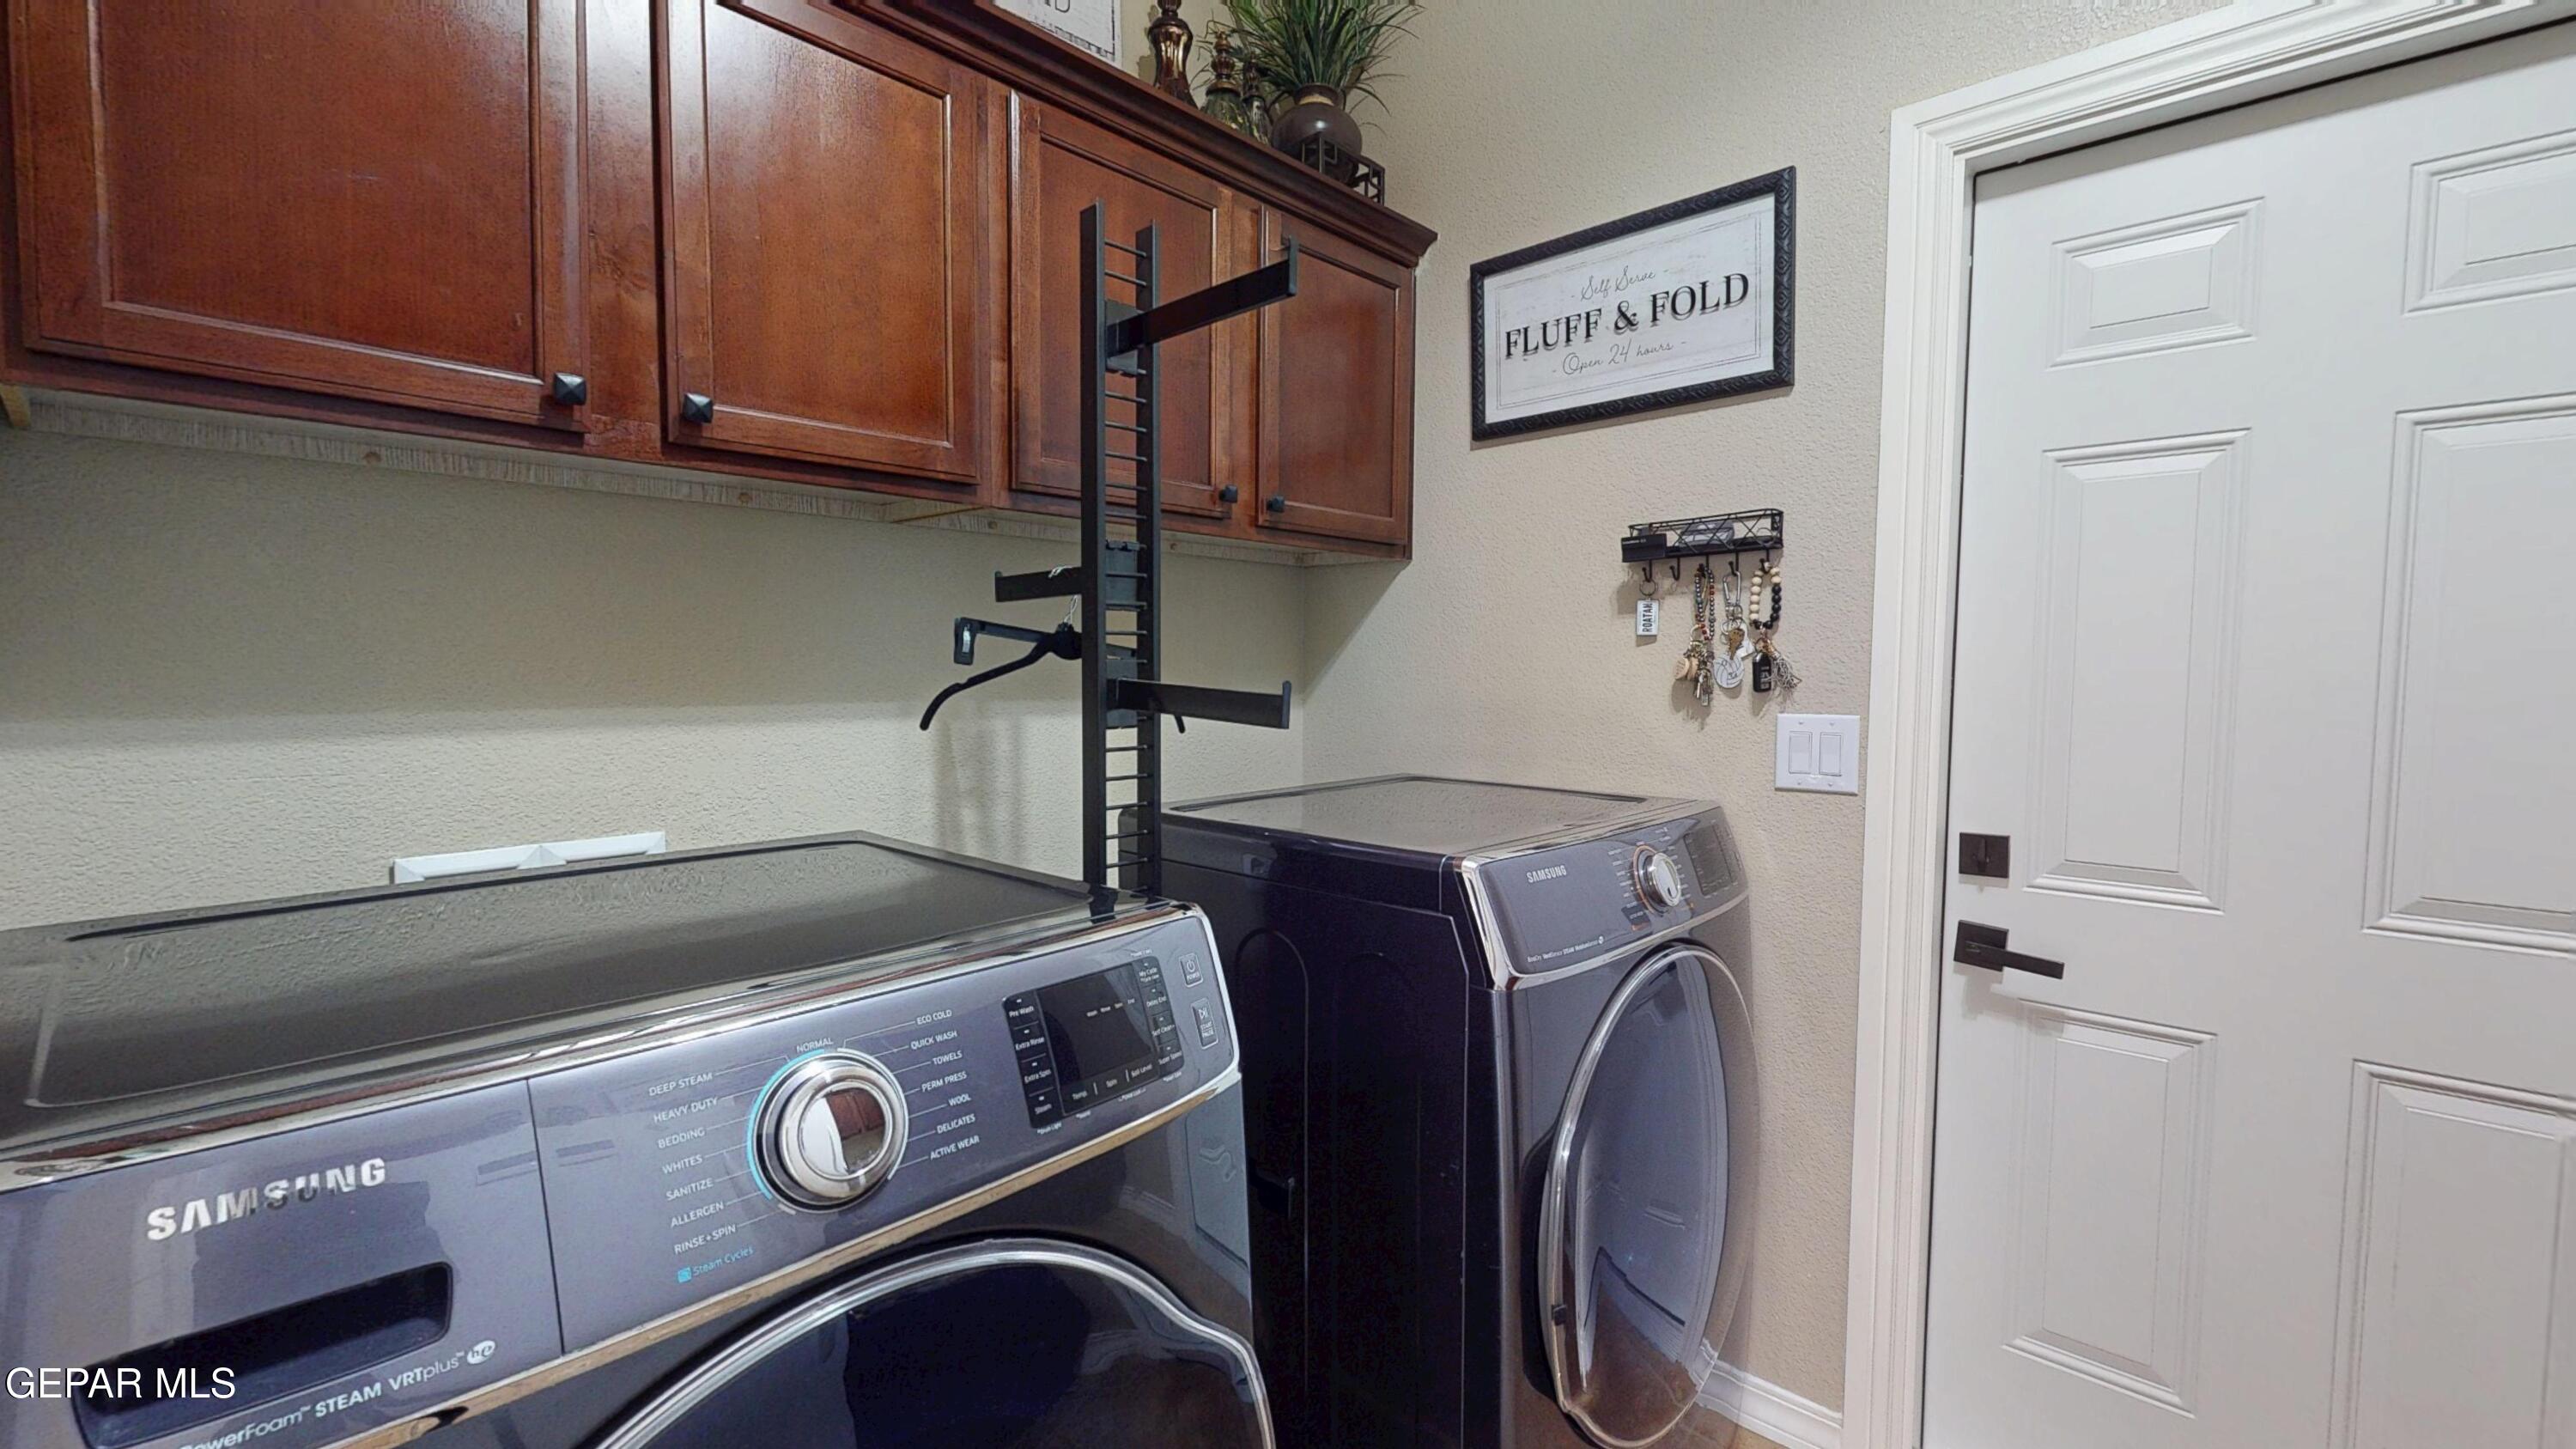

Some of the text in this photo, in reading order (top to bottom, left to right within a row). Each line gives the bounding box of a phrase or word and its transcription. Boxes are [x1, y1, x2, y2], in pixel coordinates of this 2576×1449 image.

[1581, 265, 1656, 301] Self Serve
[1505, 272, 1749, 359] FLUFF & FOLD
[1563, 338, 1674, 375] Open 24 hours
[1526, 865, 1567, 883] SAMSUNG
[916, 1009, 952, 1026] ECO COLD
[796, 1037, 834, 1053] NORMAL
[910, 1031, 957, 1050] QUICK WASH
[933, 1050, 963, 1065] TOWELS
[648, 1072, 713, 1096] DEEP STEAM
[921, 1070, 967, 1093] PERM PRESS
[653, 1096, 718, 1123] HEAVY DUTY
[948, 1093, 971, 1106] WOOL
[937, 1113, 975, 1135] DELICATES
[658, 1127, 706, 1148] BEDDING
[930, 1135, 980, 1160] ACTIVE WEAR
[662, 1154, 702, 1174] WHITES
[147, 1156, 387, 1241] SAMSUNG
[665, 1177, 714, 1201] SANITIZE
[671, 1201, 725, 1228] ALLERGEN
[693, 1245, 754, 1276] Steam Cycles
[314, 1380, 382, 1419] STEAM
